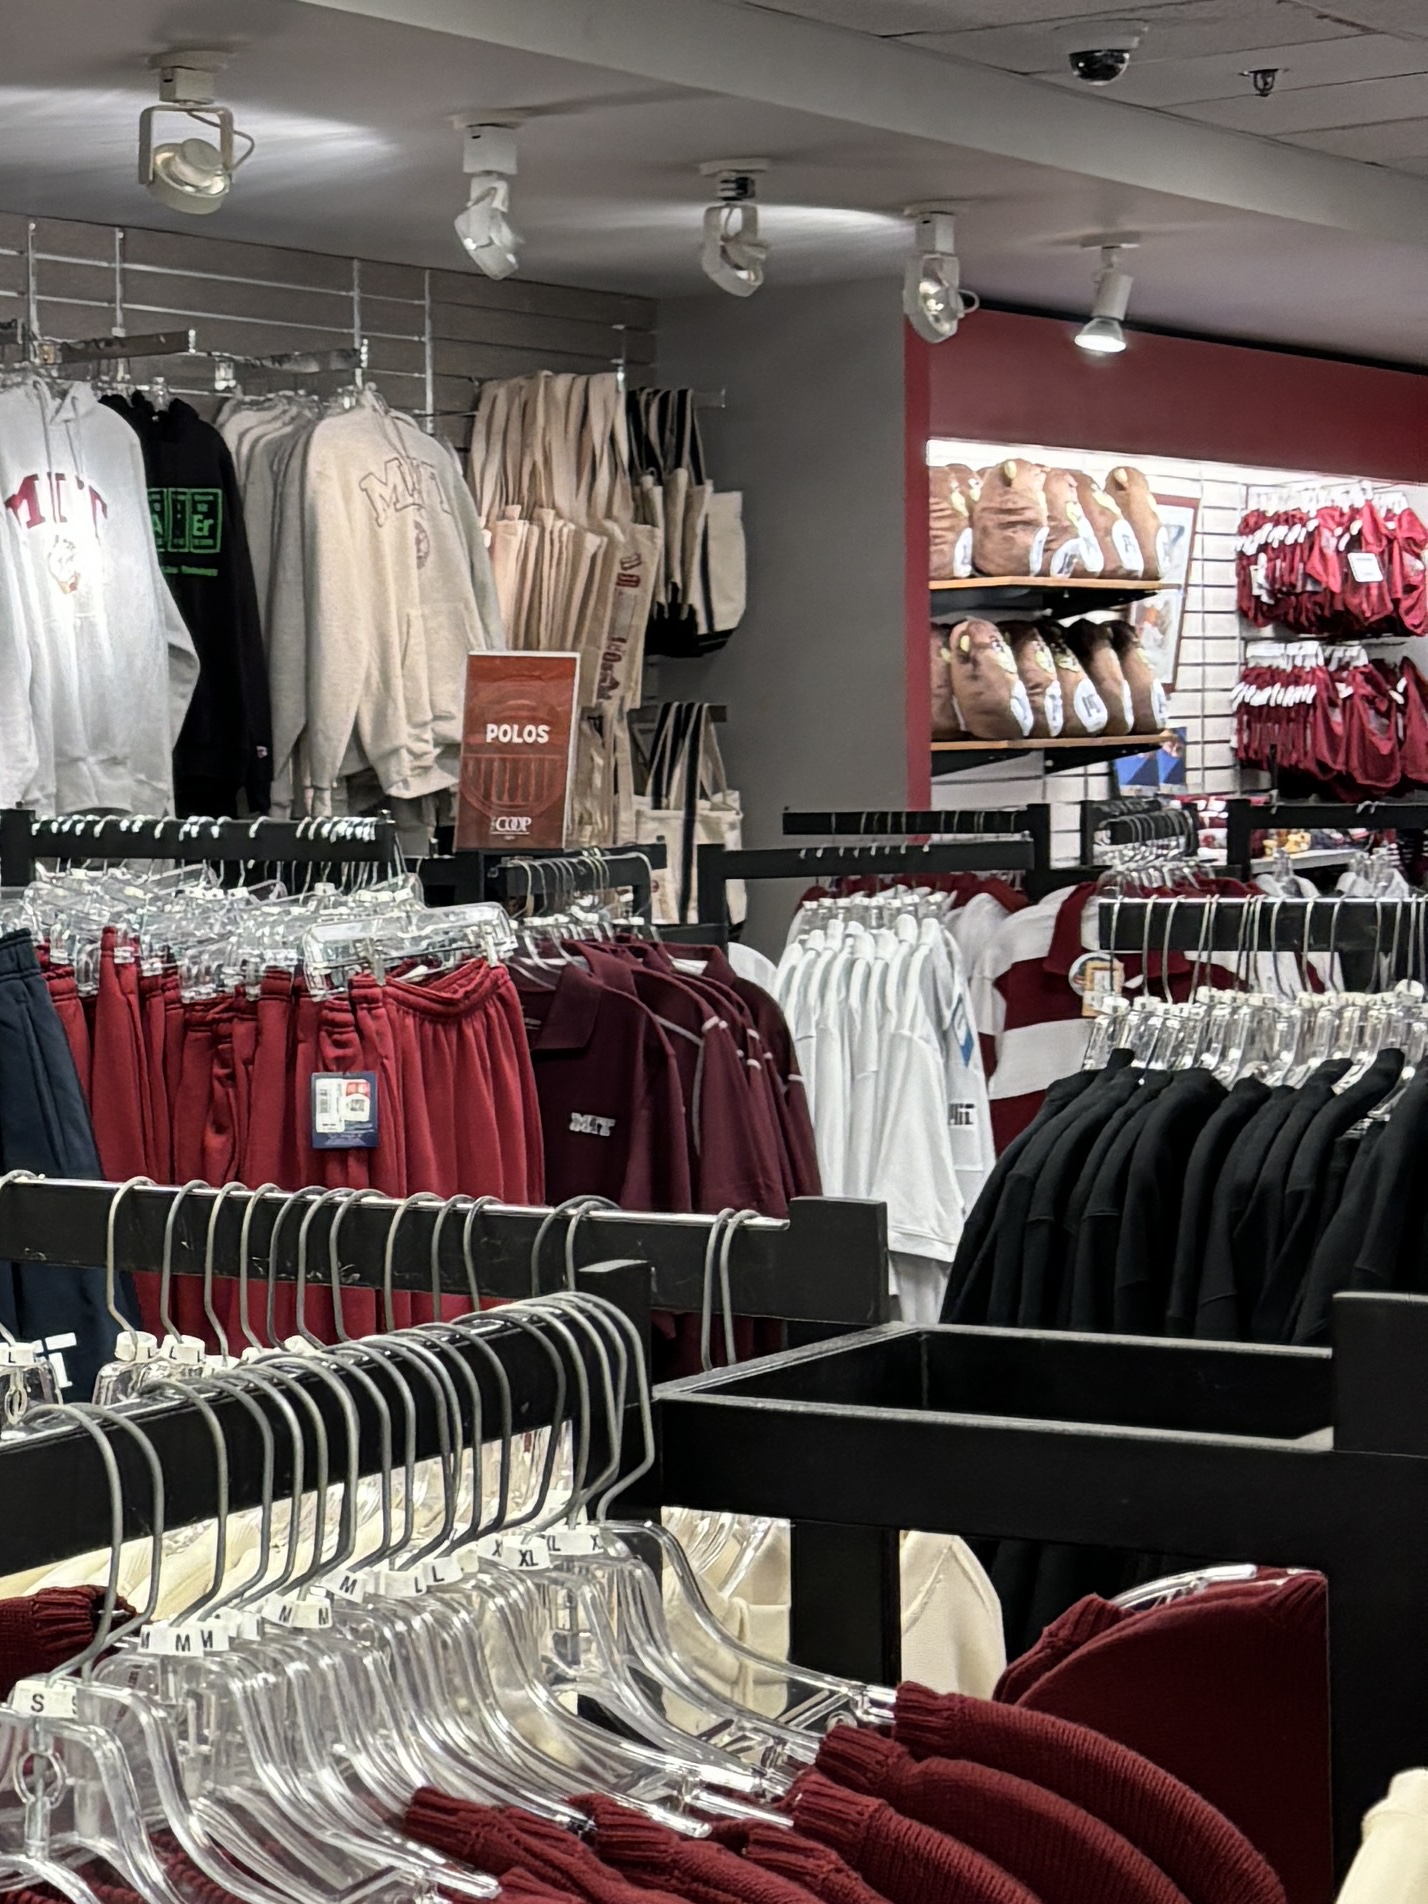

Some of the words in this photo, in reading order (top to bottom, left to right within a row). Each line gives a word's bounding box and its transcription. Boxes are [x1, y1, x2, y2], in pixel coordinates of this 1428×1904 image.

[486, 723, 552, 744] POLOS
[496, 816, 533, 833] COOP
[569, 1112, 616, 1136] MIT
[8, 1350, 16, 1364] L
[519, 1549, 539, 1568] XL
[432, 1565, 445, 1583] L
[339, 1575, 358, 1596] M
[176, 1634, 191, 1653] M
[30, 1693, 45, 1713] S
